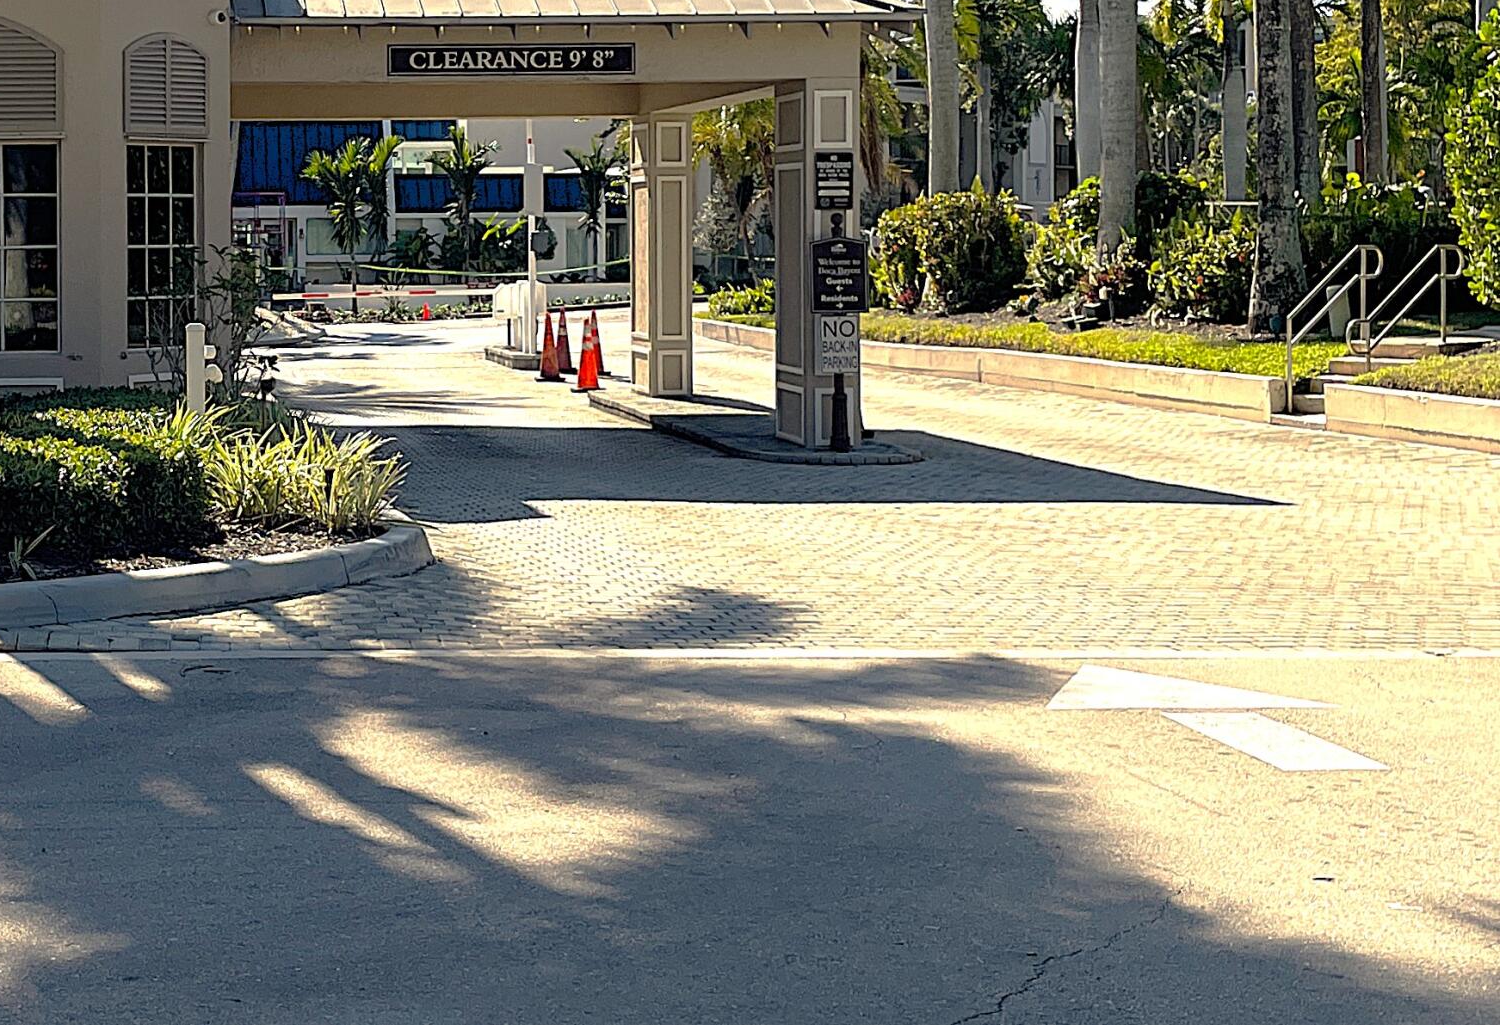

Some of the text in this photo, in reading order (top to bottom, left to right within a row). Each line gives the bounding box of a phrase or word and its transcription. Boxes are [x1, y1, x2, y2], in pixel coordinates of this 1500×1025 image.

[409, 50, 563, 70] CLEARANCE
[817, 257, 861, 266] Welcome to
[825, 277, 853, 285] Guests
[820, 294, 858, 302] Residents
[823, 320, 856, 337] NO
[822, 340, 858, 353] BACK-IN
[822, 356, 858, 369] PARKING
